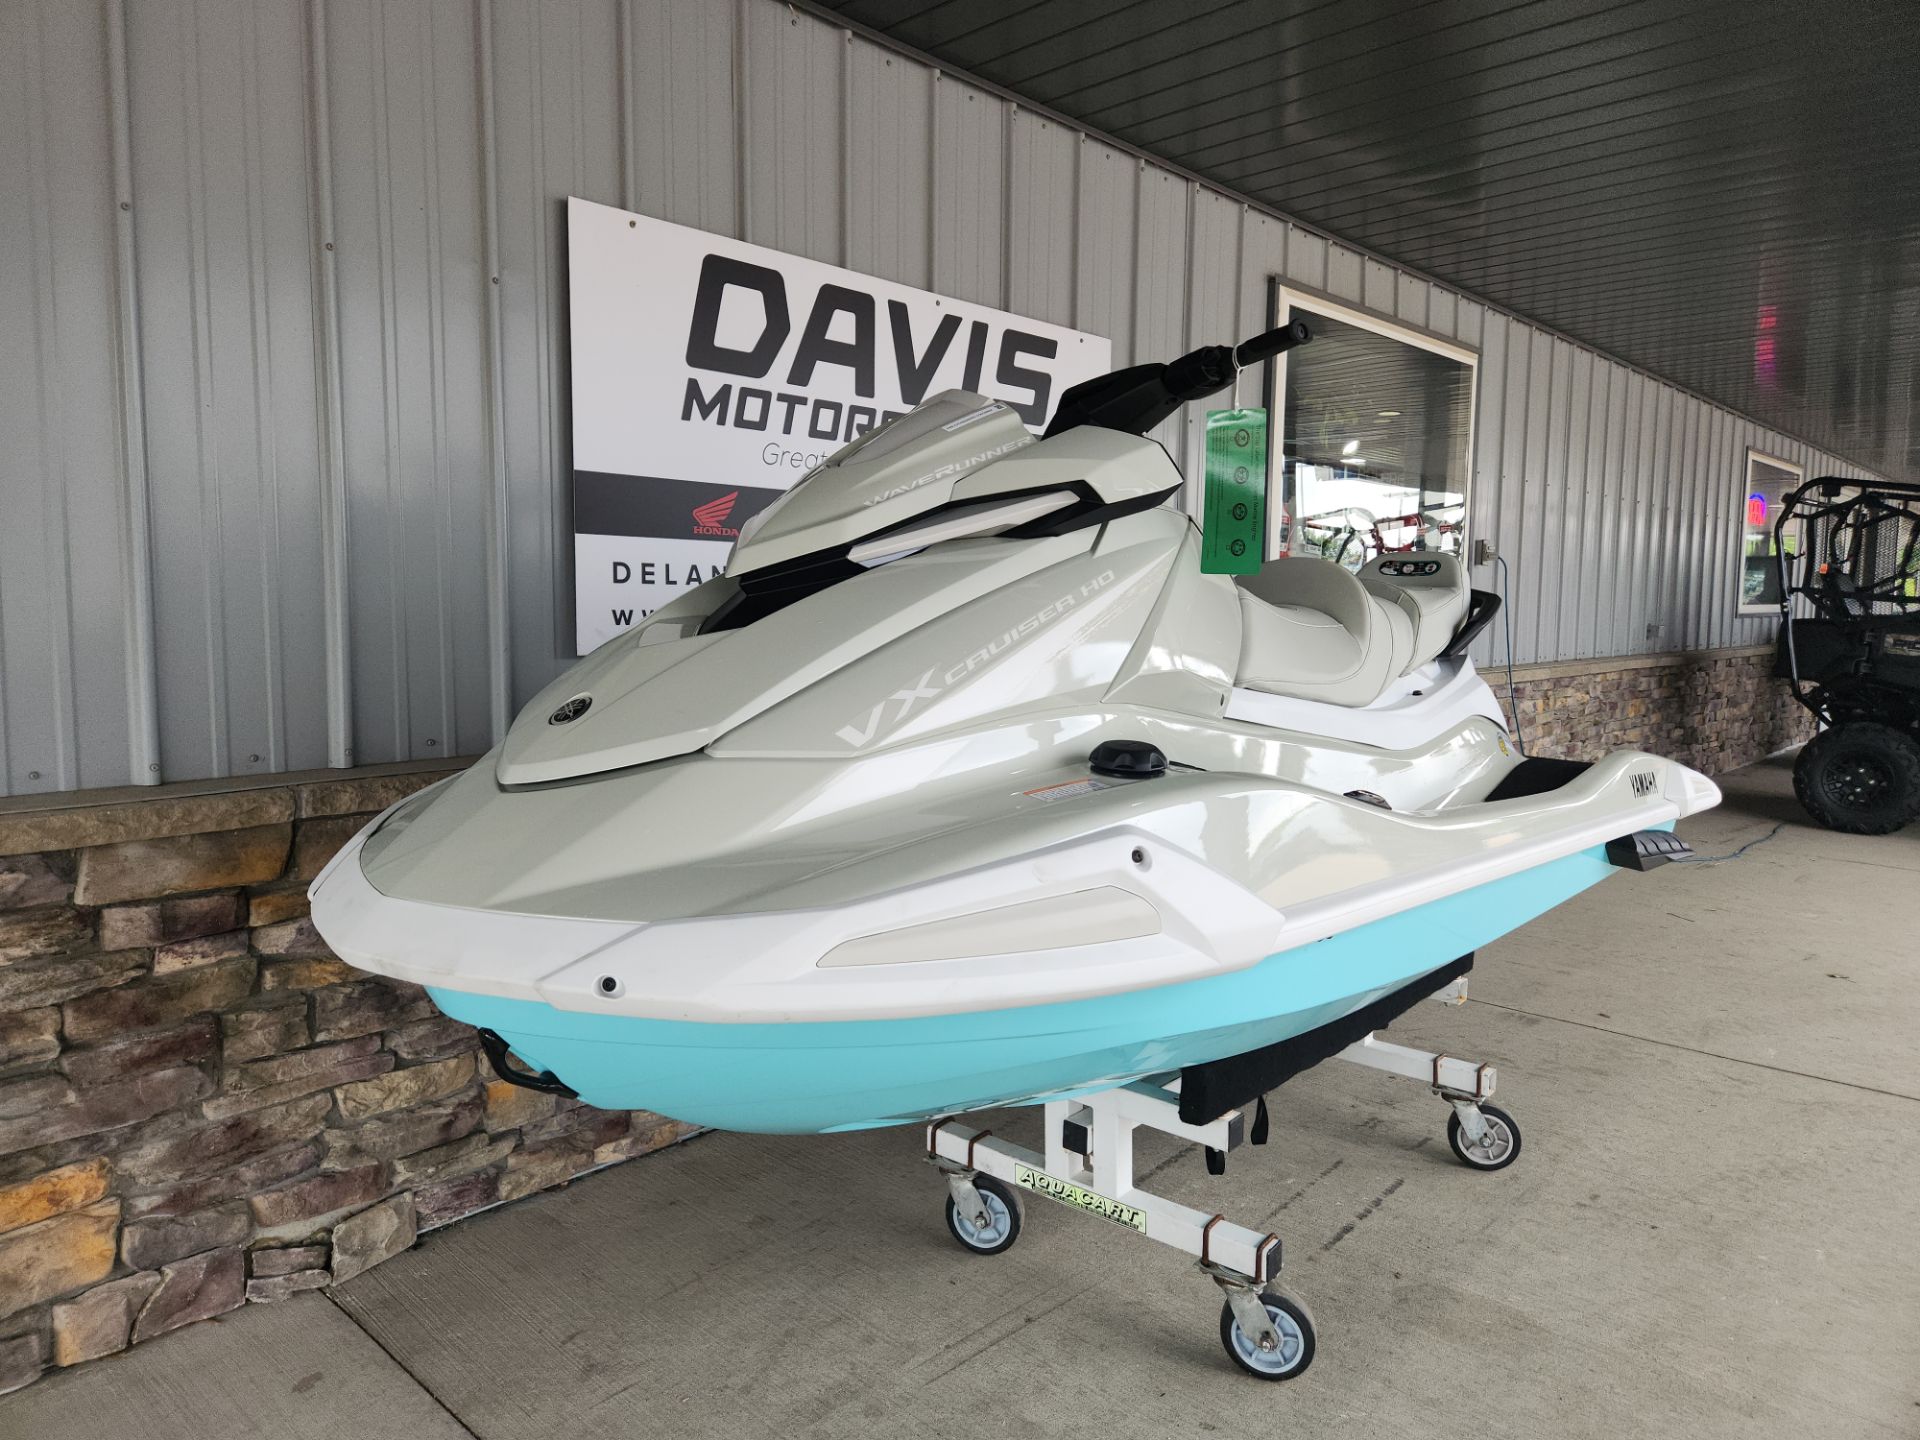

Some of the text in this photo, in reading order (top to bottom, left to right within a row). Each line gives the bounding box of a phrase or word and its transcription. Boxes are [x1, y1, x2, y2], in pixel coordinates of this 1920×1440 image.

[686, 253, 1059, 427] DAVIS
[681, 377, 911, 443] MOTOR
[863, 436, 1032, 506] WAVERUNNER
[693, 526, 739, 537] HONDA
[835, 570, 1115, 748] VX CRUISER HO
[1629, 771, 1659, 799] YAMAHA
[1020, 1169, 1140, 1223] AQUACART
